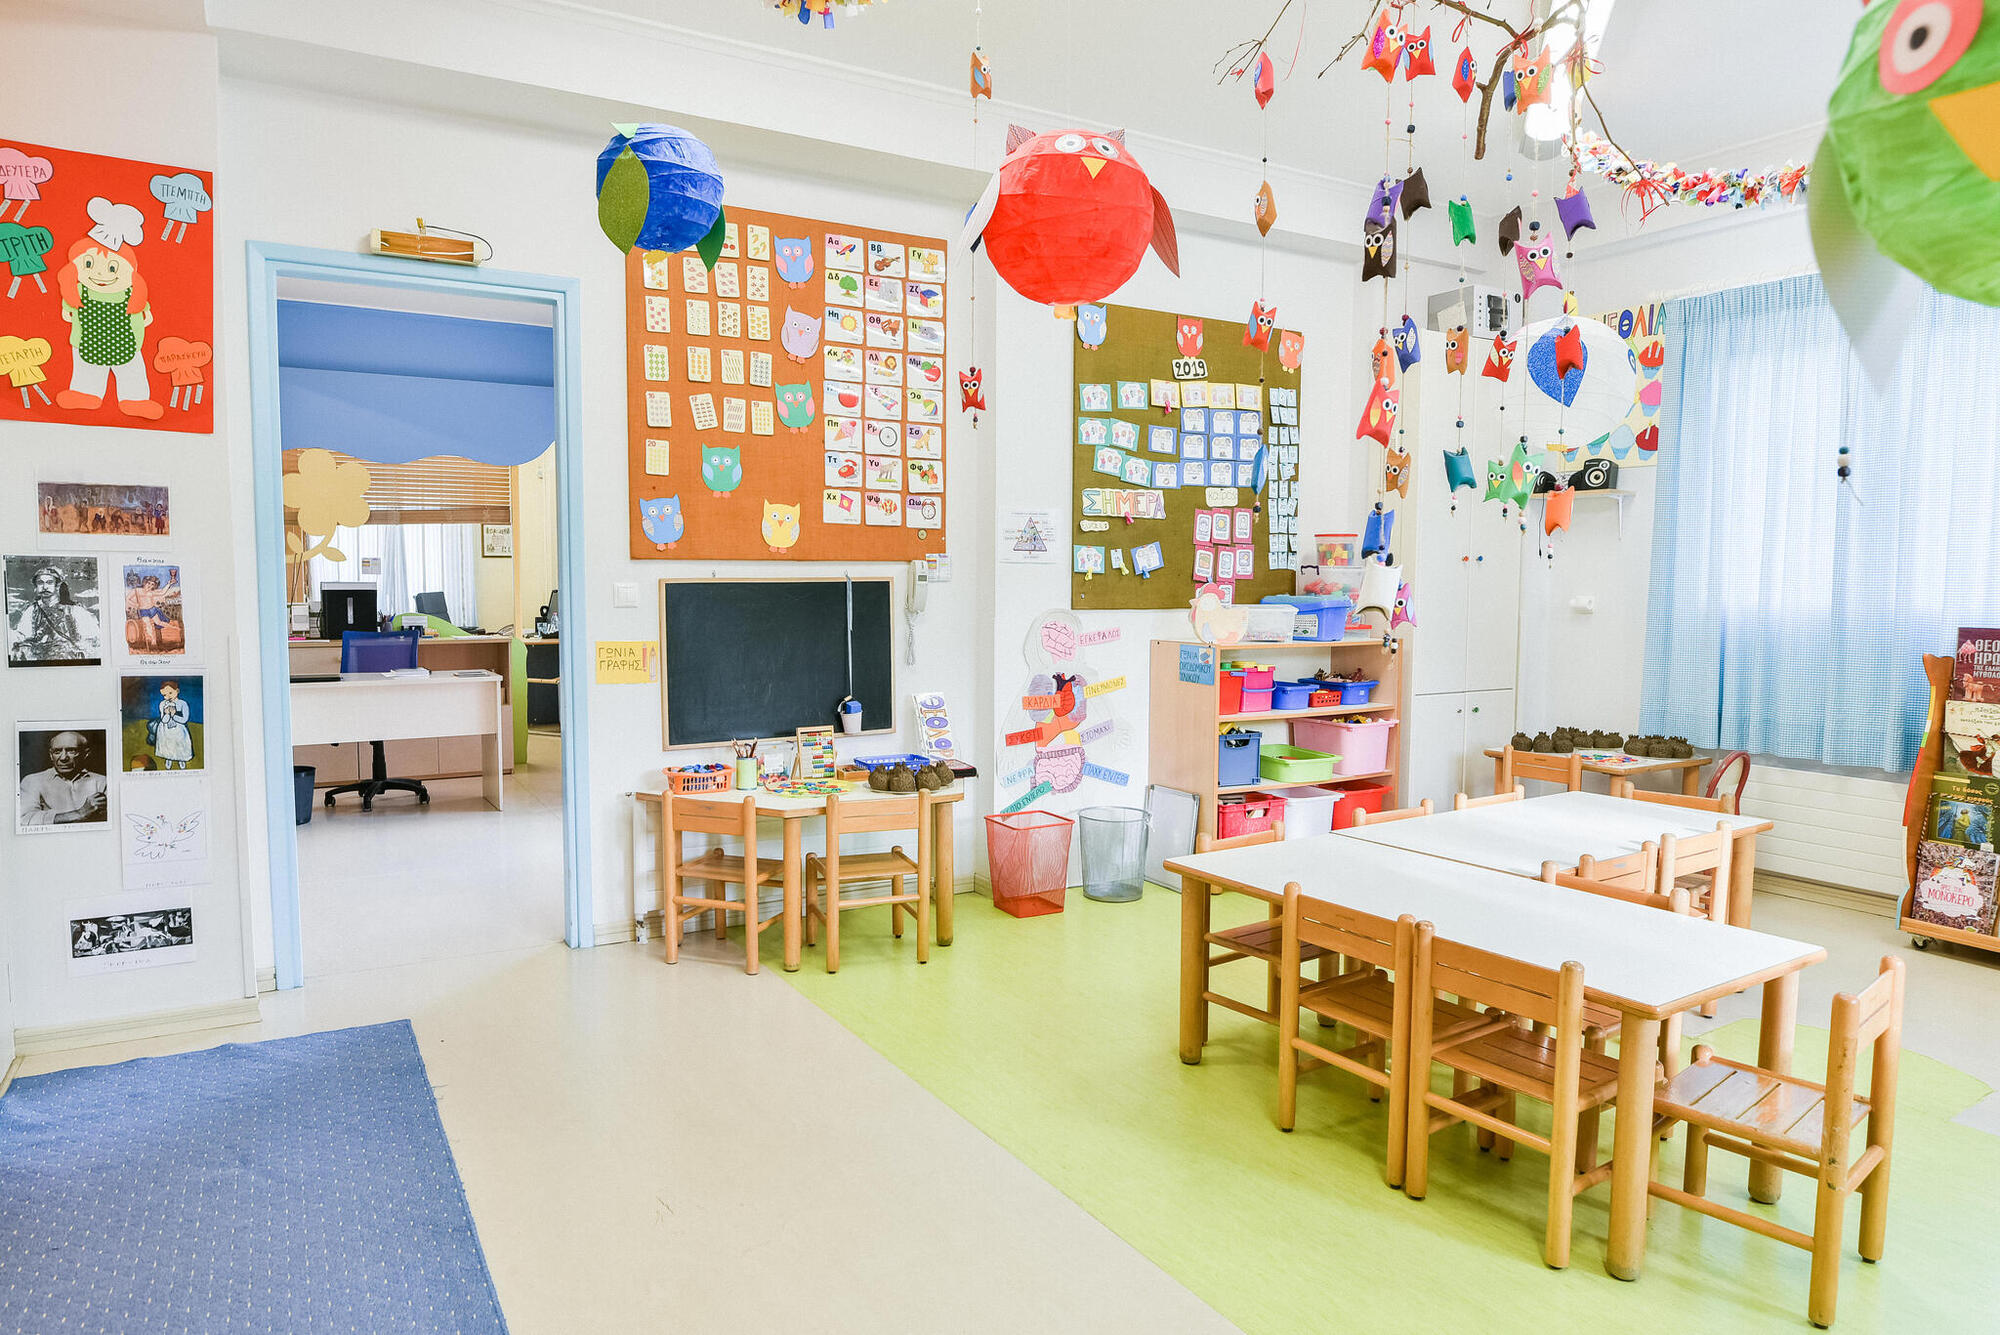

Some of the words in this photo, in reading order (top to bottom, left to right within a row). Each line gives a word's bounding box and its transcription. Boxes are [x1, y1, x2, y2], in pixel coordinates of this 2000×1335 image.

[160, 183, 206, 205] ΠΕΜΠΤΗ
[0, 232, 49, 258] ΤΡΙΤΗ
[828, 237, 839, 246] Αα
[871, 244, 882, 253] Ββ
[912, 250, 922, 259] Γγ
[828, 272, 840, 280] Δδ
[910, 286, 919, 294] Ζζ
[828, 311, 839, 320] Ηη
[909, 358, 921, 367] Μμ
[1175, 361, 1206, 377] 2019
[910, 463, 924, 472] Φφ
[867, 495, 880, 504] Ψψ
[1083, 490, 1165, 519] ΣΗΜΕΡΑ
[598, 648, 635, 658] ΓΩΝΙΑ
[600, 660, 642, 671] ΓΡΑΦΗΣ
[1028, 696, 1057, 708] ΚΑΡΔΙΑ
[1927, 888, 1975, 907] ΜΟΝΟΚΕΡΟ
